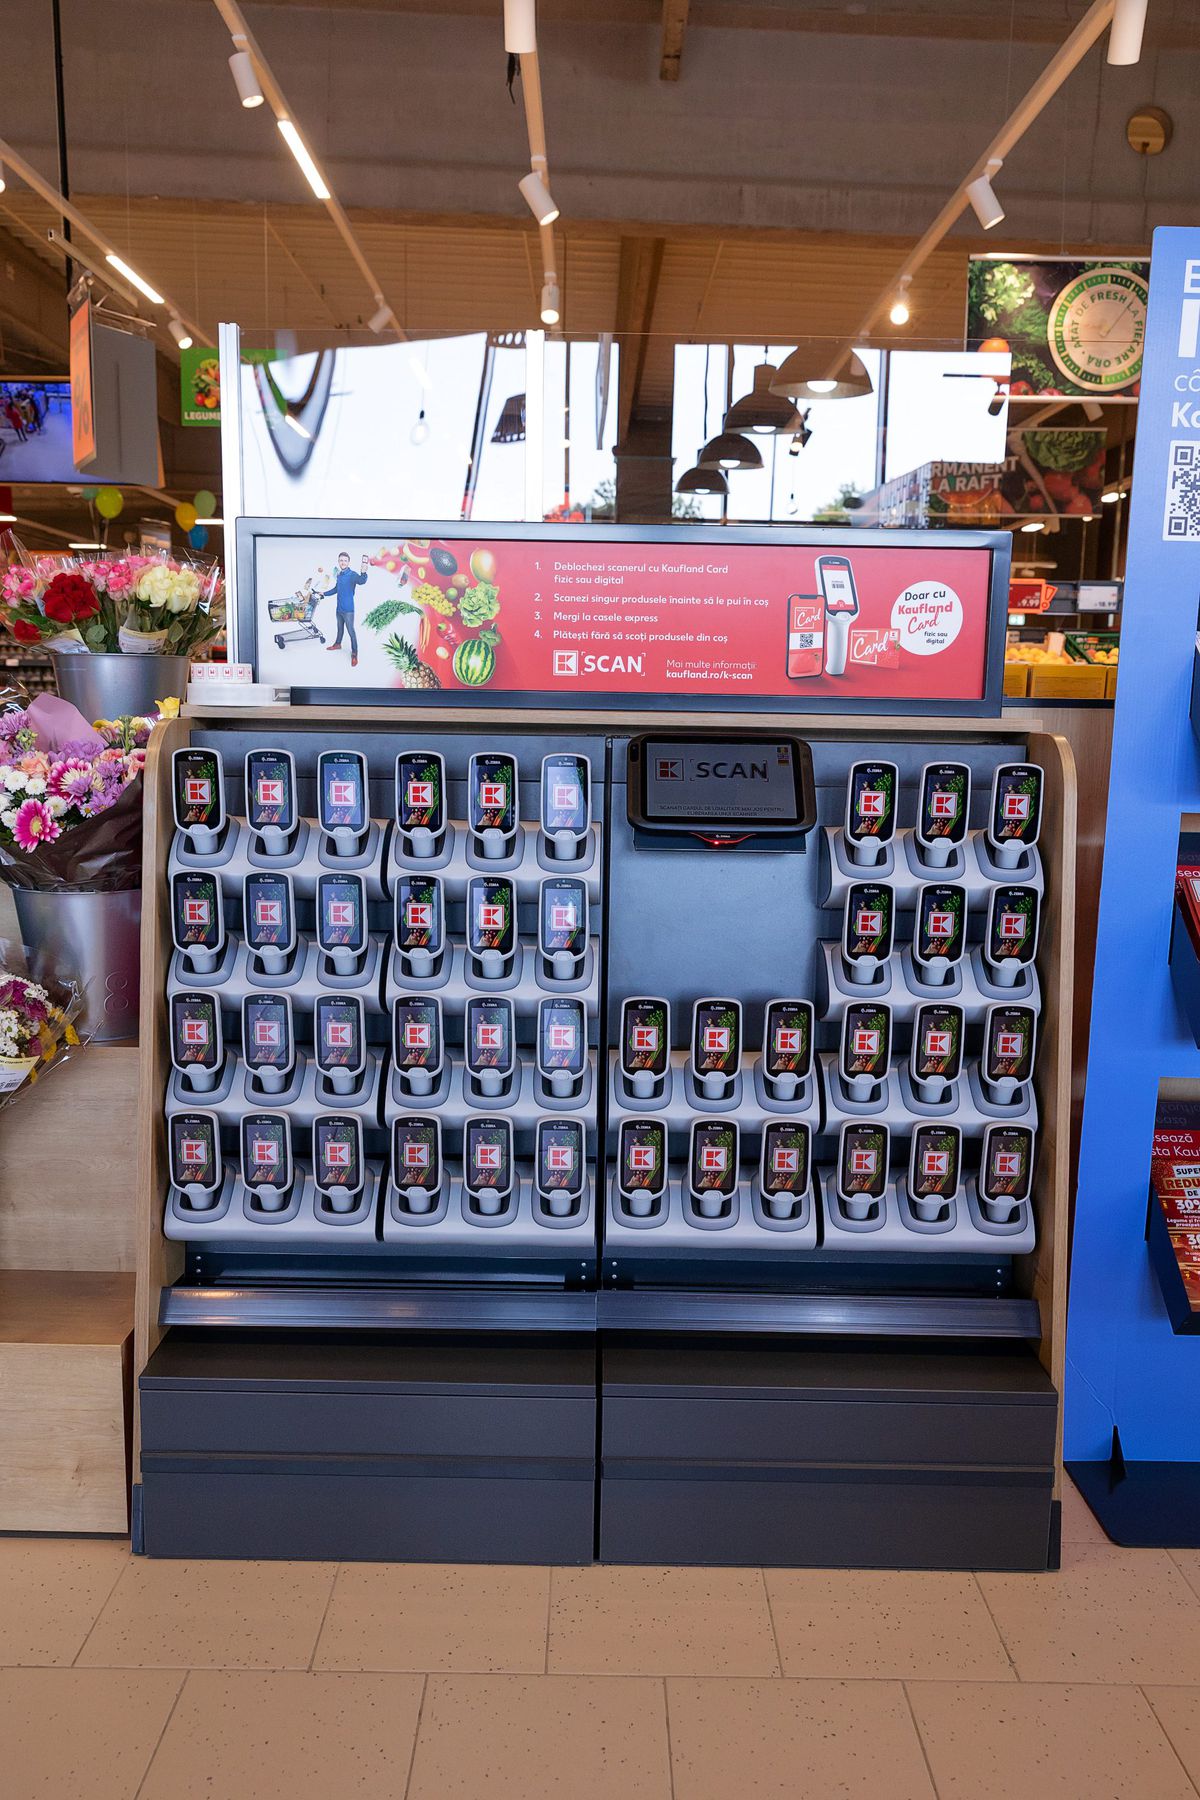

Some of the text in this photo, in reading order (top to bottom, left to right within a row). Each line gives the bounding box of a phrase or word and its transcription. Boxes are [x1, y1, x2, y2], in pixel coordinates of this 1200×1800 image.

[1075, 301, 1089, 316] DE
[1090, 290, 1127, 304] FRESH
[1126, 301, 1139, 318] LA
[929, 473, 1003, 494] LA RAFT
[534, 562, 729, 574] 1. Deblochezi scanerul cu Kaufland Card
[554, 575, 624, 586] fizic sau digital
[534, 593, 542, 602] 2.
[553, 593, 589, 603] Scanezi
[591, 594, 619, 605] singur
[622, 595, 667, 605] produsele
[716, 596, 724, 606] le
[726, 597, 741, 607] pui
[904, 590, 946, 601] Doar cu
[898, 601, 953, 615] Kaufland
[534, 611, 658, 624] 3. Mergi la casele express
[797, 608, 821, 626] Card
[907, 609, 940, 634] Card
[533, 630, 542, 639] 4.
[649, 633, 694, 644] produsele
[696, 633, 710, 642] din
[853, 632, 889, 659] Card
[584, 655, 642, 673] SCAN
[666, 660, 683, 669] Mai
[685, 660, 711, 669] multe
[666, 670, 753, 680] kaufland.ro/k-scan
[696, 762, 768, 780] SCAN
[1153, 1133, 1193, 1143] sează
